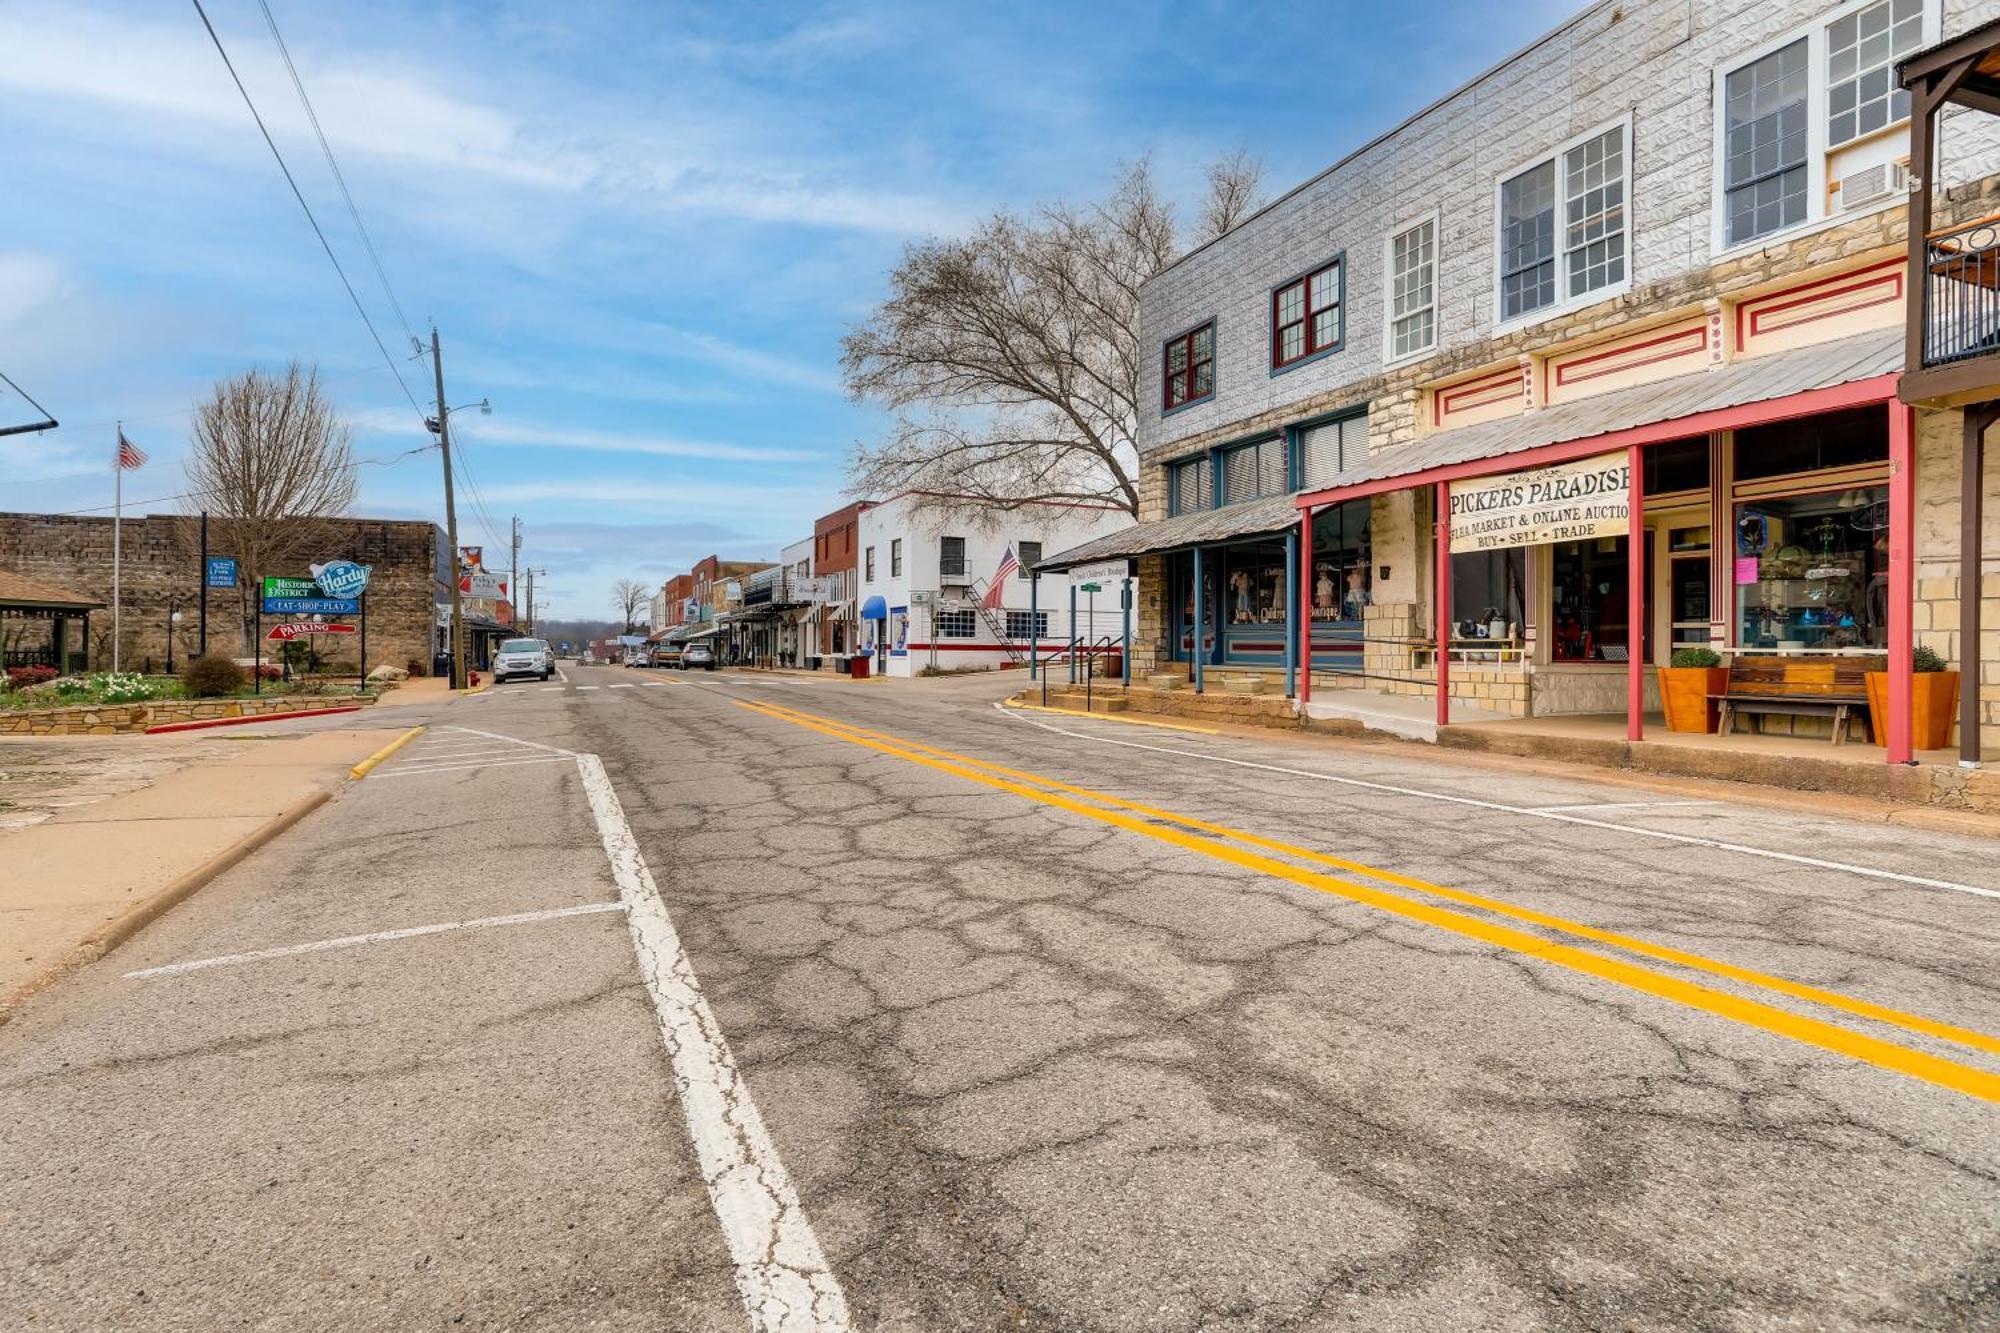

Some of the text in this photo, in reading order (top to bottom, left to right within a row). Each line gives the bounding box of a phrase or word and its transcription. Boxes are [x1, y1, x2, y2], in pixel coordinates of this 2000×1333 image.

[1451, 466, 1630, 515] PICKERS PARADISE
[1449, 526, 1470, 541] FLEA
[1471, 516, 1516, 535] MARKET
[1518, 514, 1530, 526] &
[1532, 508, 1581, 525] ONLINE
[1478, 523, 1596, 547] BUY SELL TRADE
[319, 567, 368, 592] Hardy
[280, 623, 329, 637] PARKING
